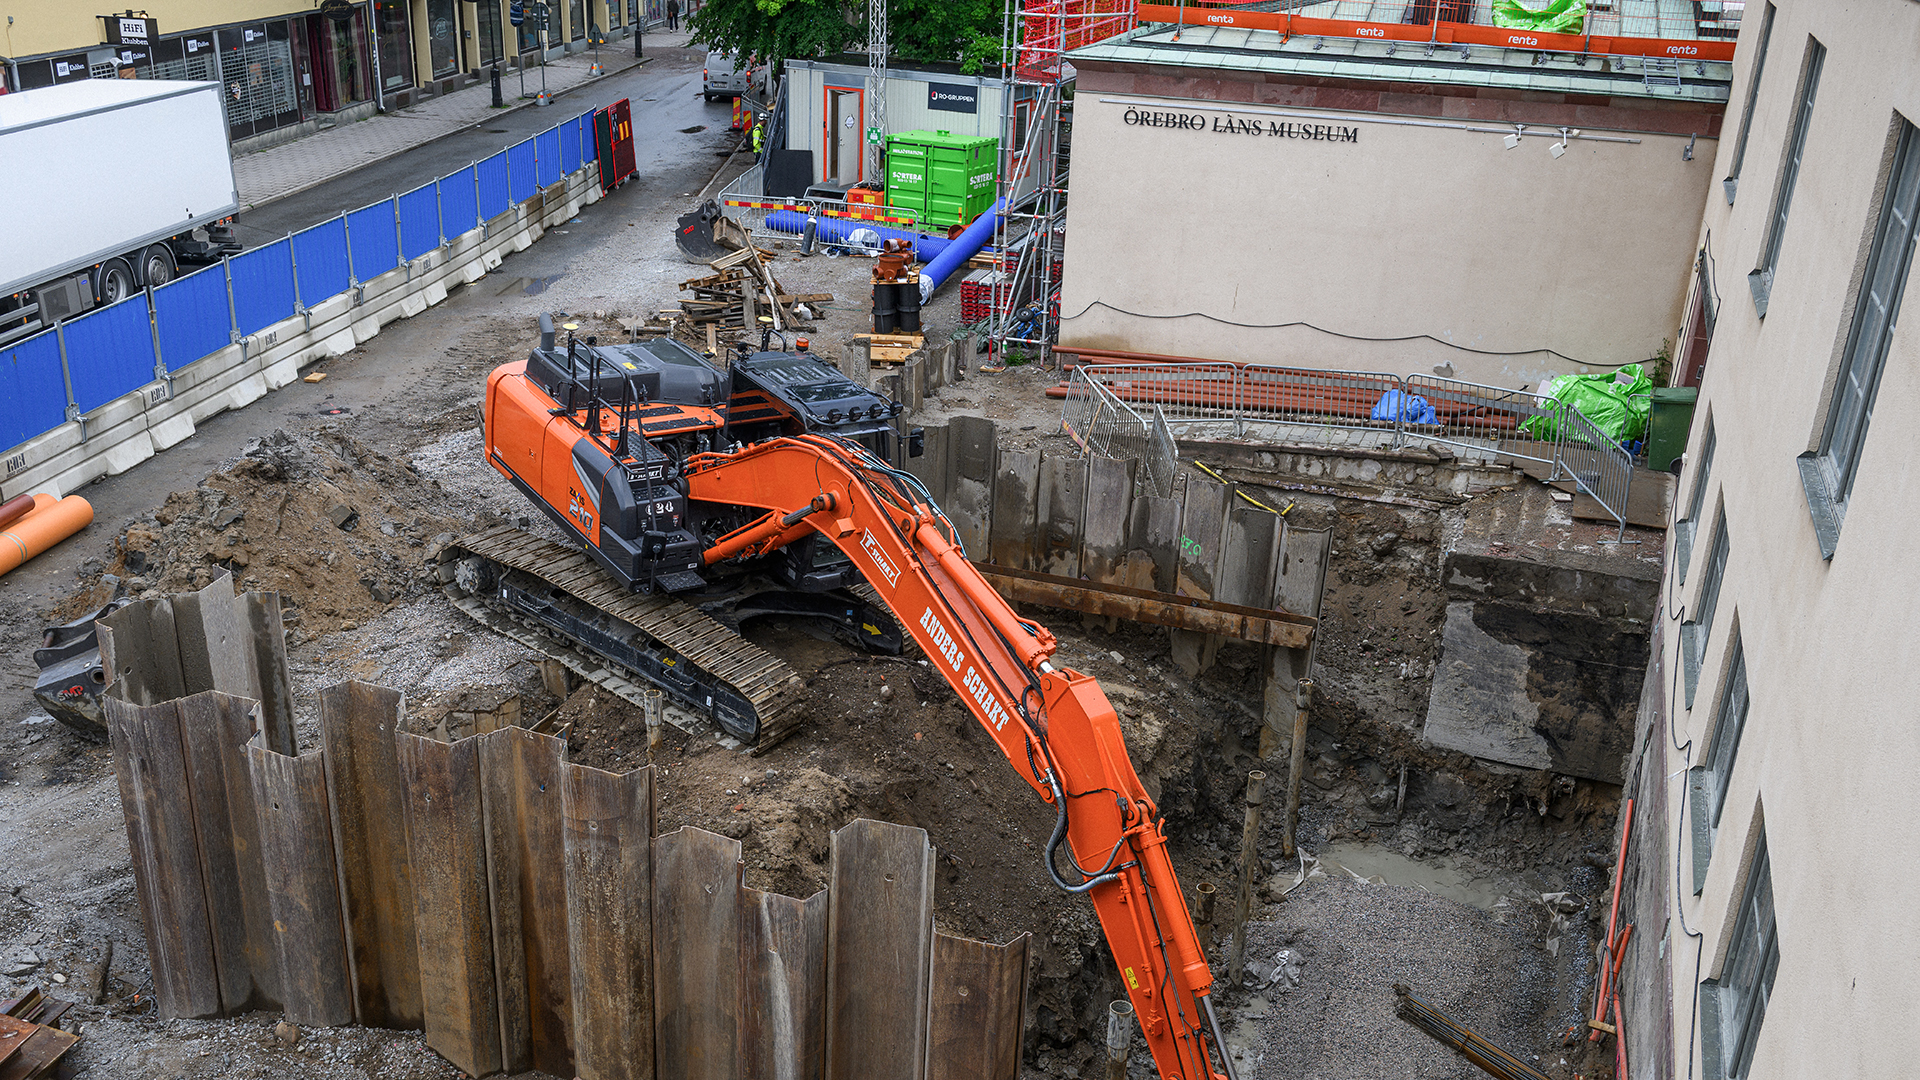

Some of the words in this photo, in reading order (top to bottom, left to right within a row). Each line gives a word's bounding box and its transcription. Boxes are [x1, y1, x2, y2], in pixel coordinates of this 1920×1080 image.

[1207, 14, 1234, 24] renta
[122, 23, 144, 33] HiFi
[1356, 27, 1385, 37] renta
[1507, 34, 1538, 46] renta
[1666, 45, 1698, 55] renta
[938, 93, 974, 102] RO-GRUPPEN
[1123, 106, 1206, 131] ÖREBRO
[1267, 121, 1359, 144] MUSEUM
[892, 171, 923, 181] SORTERA
[969, 172, 993, 185] SORTERA
[568, 498, 594, 531] 210
[919, 606, 965, 673] ANDERS
[962, 665, 1010, 732] SCHAKT
